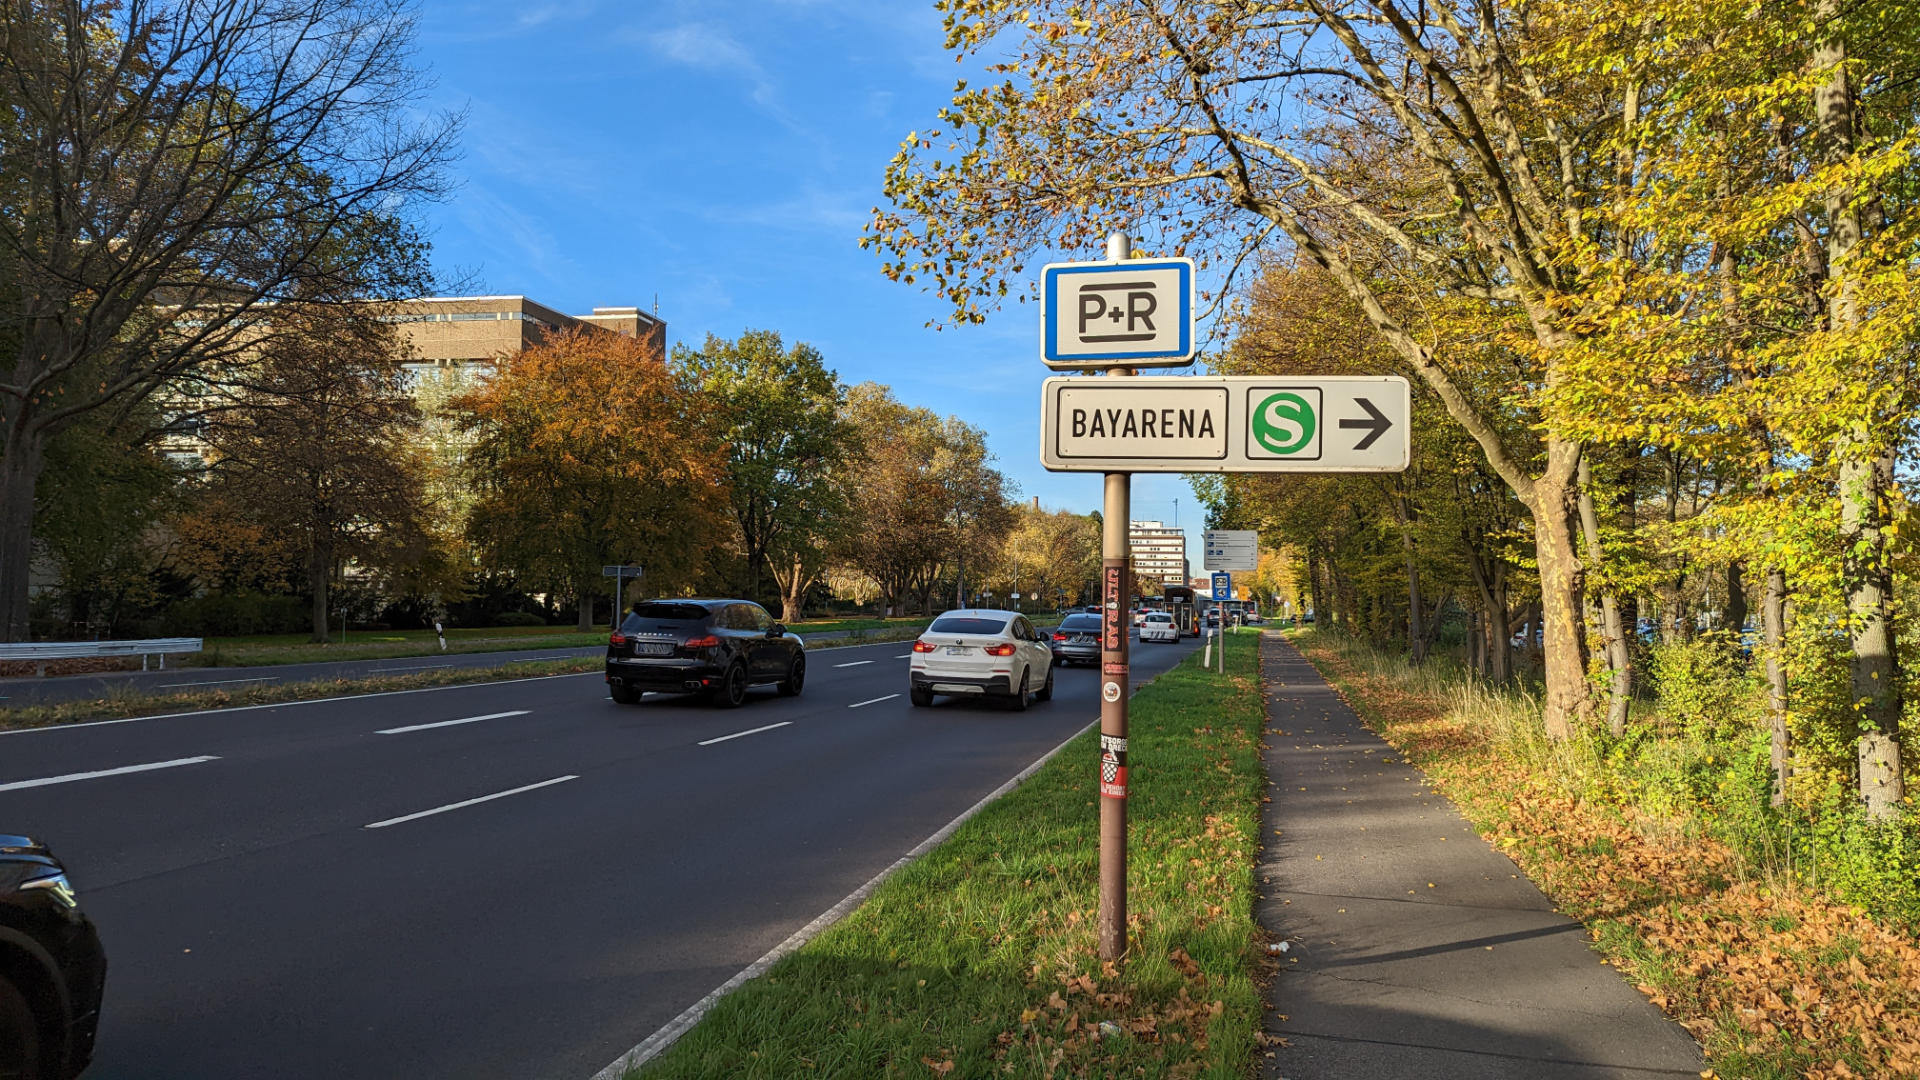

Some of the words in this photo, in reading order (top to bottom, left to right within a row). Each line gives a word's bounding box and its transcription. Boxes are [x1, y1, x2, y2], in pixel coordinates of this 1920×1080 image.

[1079, 292, 1157, 334] P+R
[1073, 408, 1215, 439] BAYARENA
[1263, 400, 1303, 447] S
[1106, 569, 1119, 649] ULTRAS
